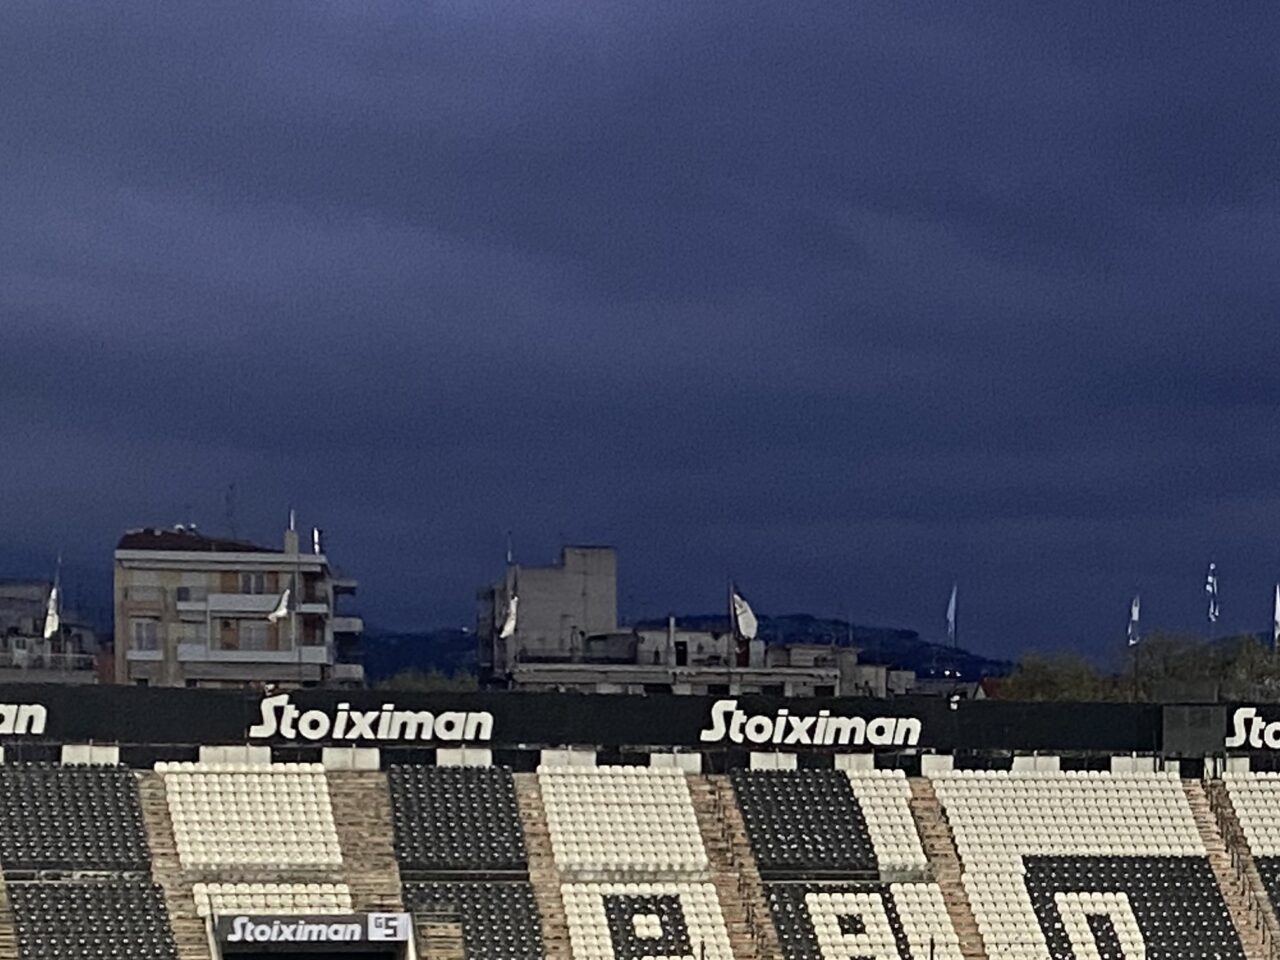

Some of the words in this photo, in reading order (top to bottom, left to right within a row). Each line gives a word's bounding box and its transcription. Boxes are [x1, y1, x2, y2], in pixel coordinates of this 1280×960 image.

[248, 693, 494, 741] Stoiximan
[700, 700, 922, 745] Stoiximan
[227, 916, 362, 942] Stoiximan
